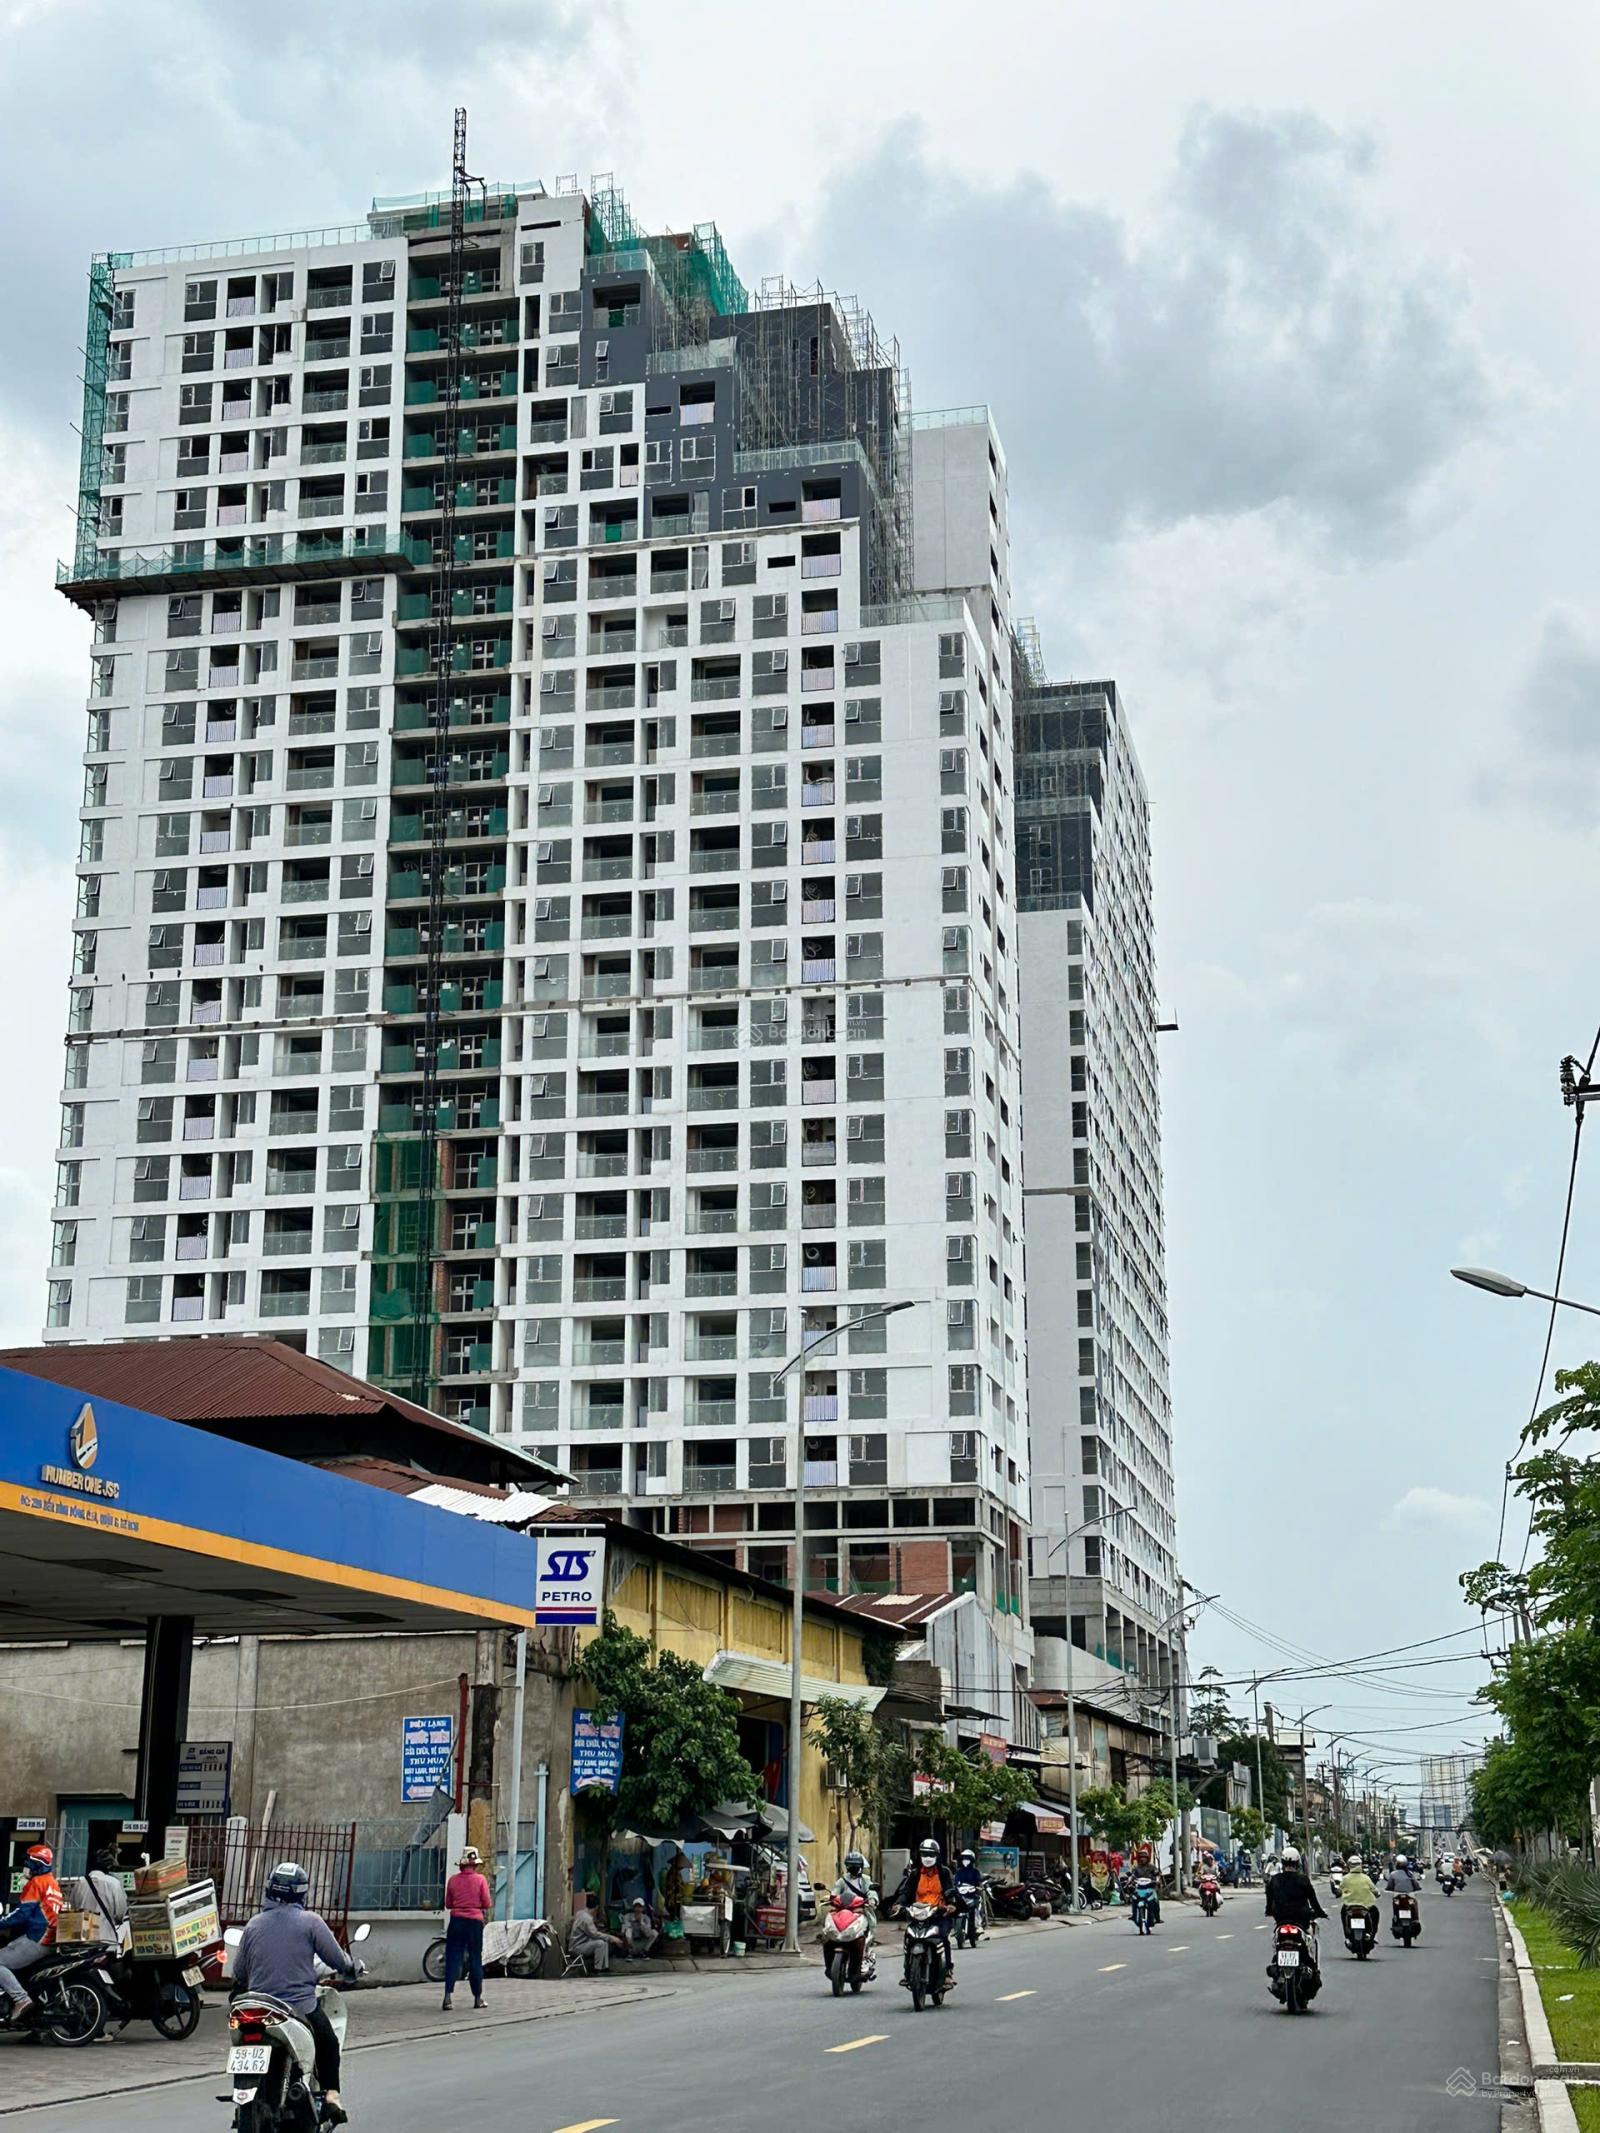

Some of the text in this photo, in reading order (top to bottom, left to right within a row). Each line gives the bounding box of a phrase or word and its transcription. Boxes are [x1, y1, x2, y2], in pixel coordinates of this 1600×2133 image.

[41, 1465, 120, 1498] NUMBER ONE JSC
[542, 1591, 592, 1602] PETRO
